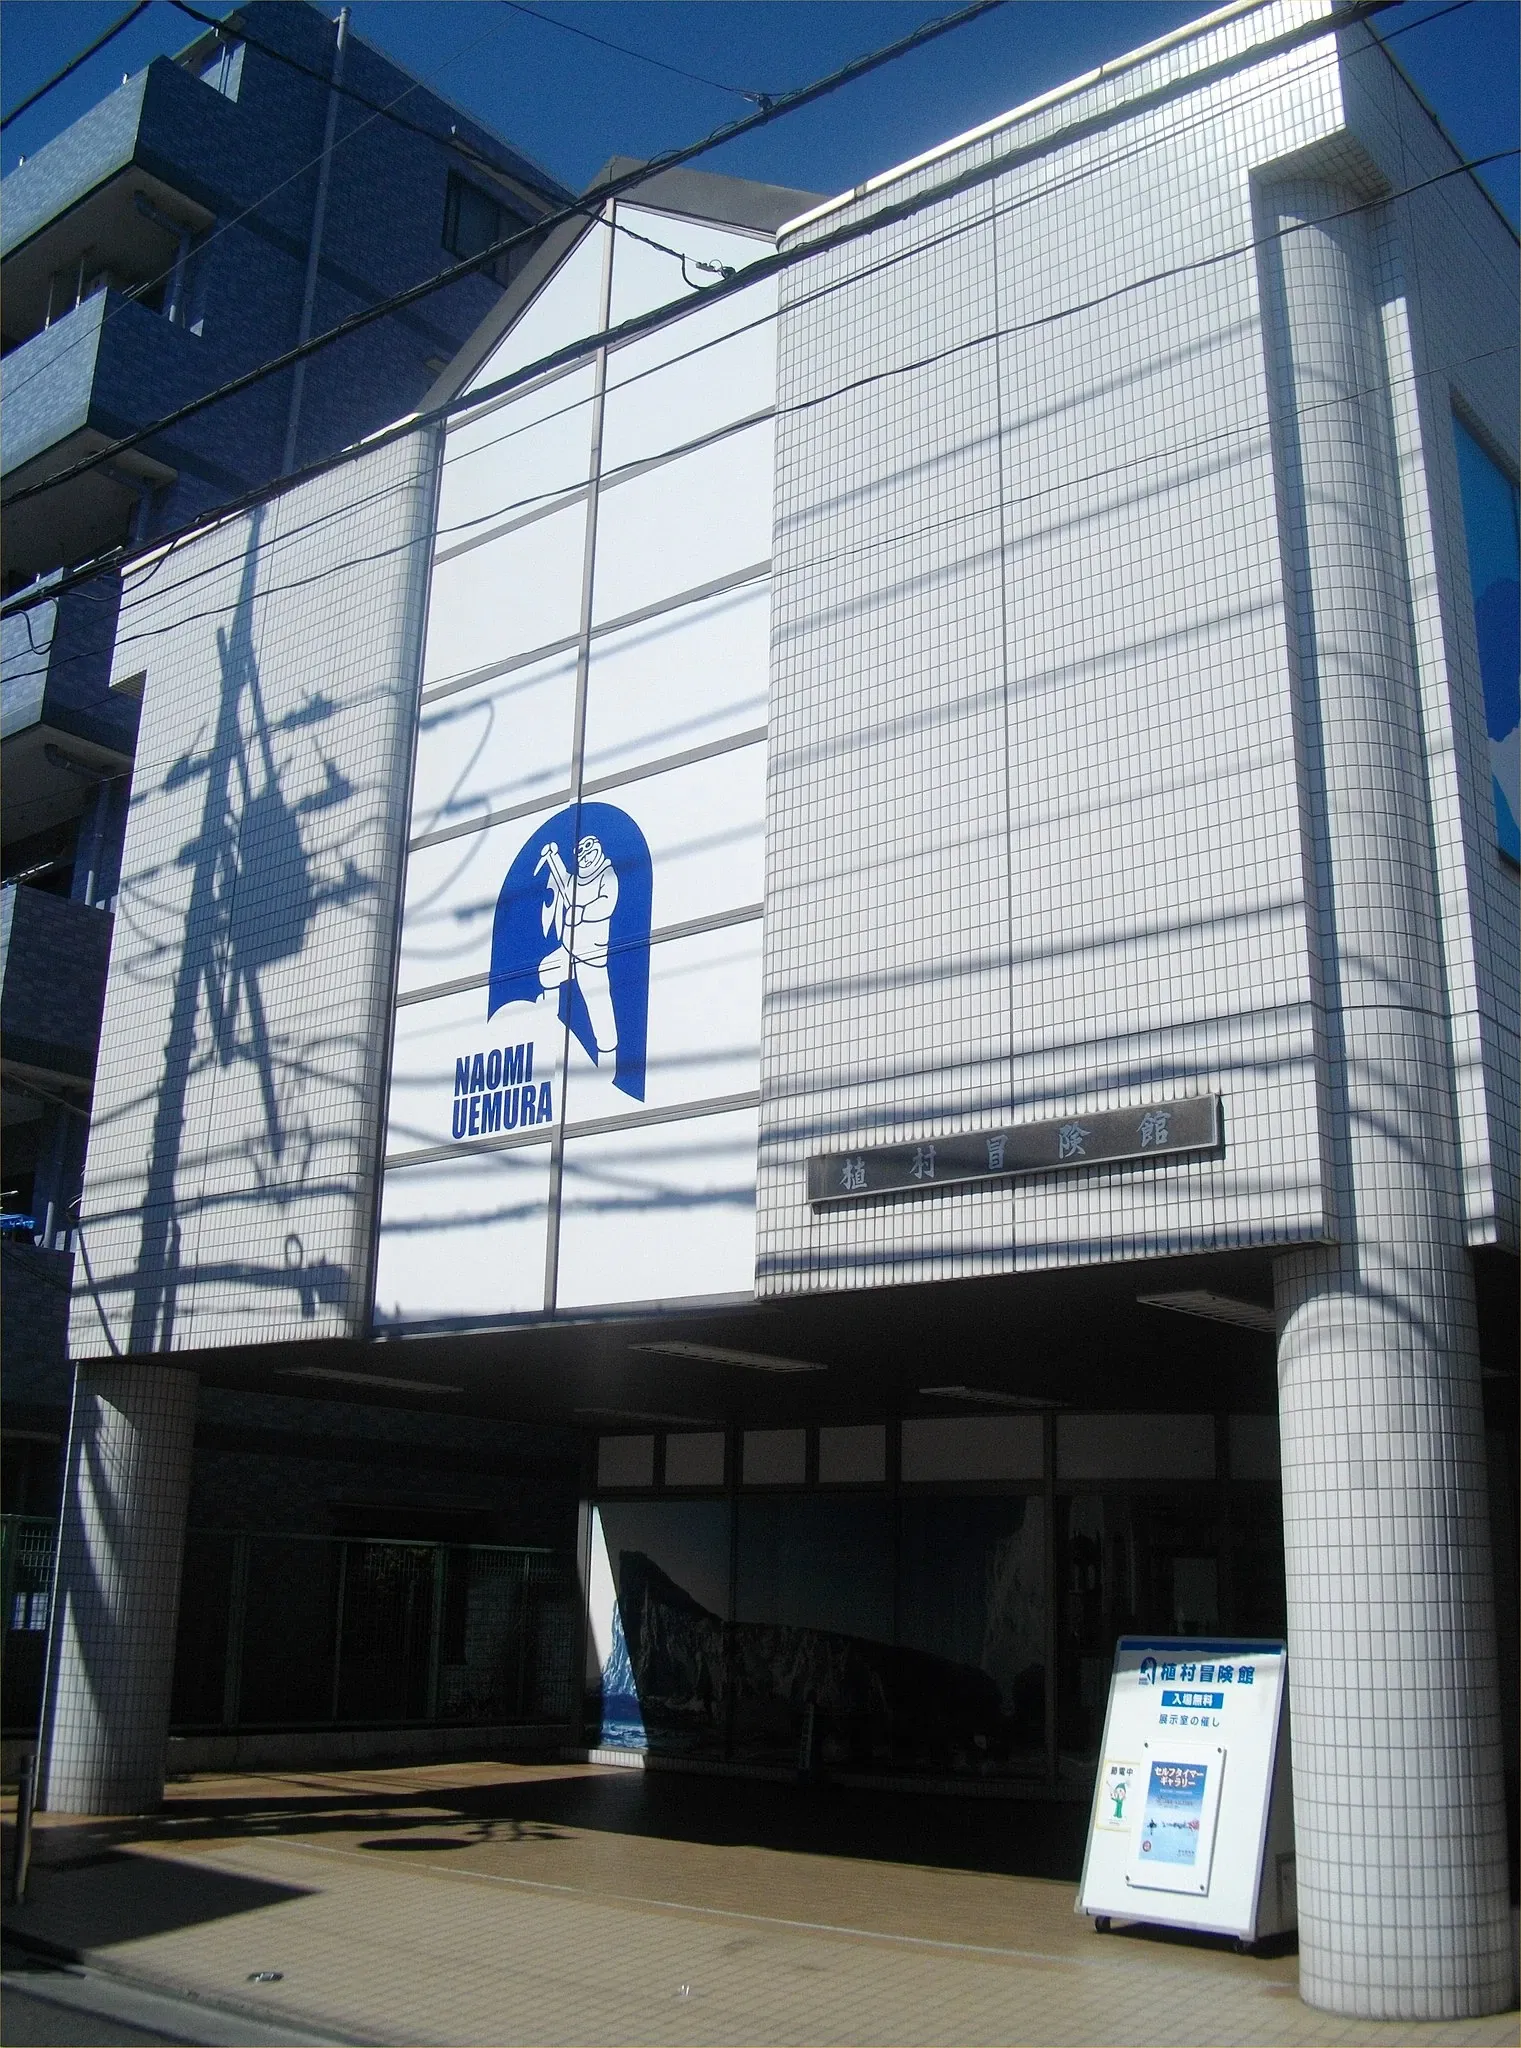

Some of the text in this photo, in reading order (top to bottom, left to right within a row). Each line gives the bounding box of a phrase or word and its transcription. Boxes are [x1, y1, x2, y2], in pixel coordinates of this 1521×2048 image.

[454, 1042, 534, 1097] NAOMI
[452, 1081, 553, 1140] UEMURA
[839, 1111, 1172, 1191] 植村冒険館
[1160, 1662, 1255, 1685] 植村冒険館
[1172, 1693, 1213, 1707] 入場無料
[1159, 1713, 1220, 1728] 展示室の催し
[1154, 1766, 1204, 1778] セルフタイマー
[1160, 1776, 1196, 1788] ギャラリー
